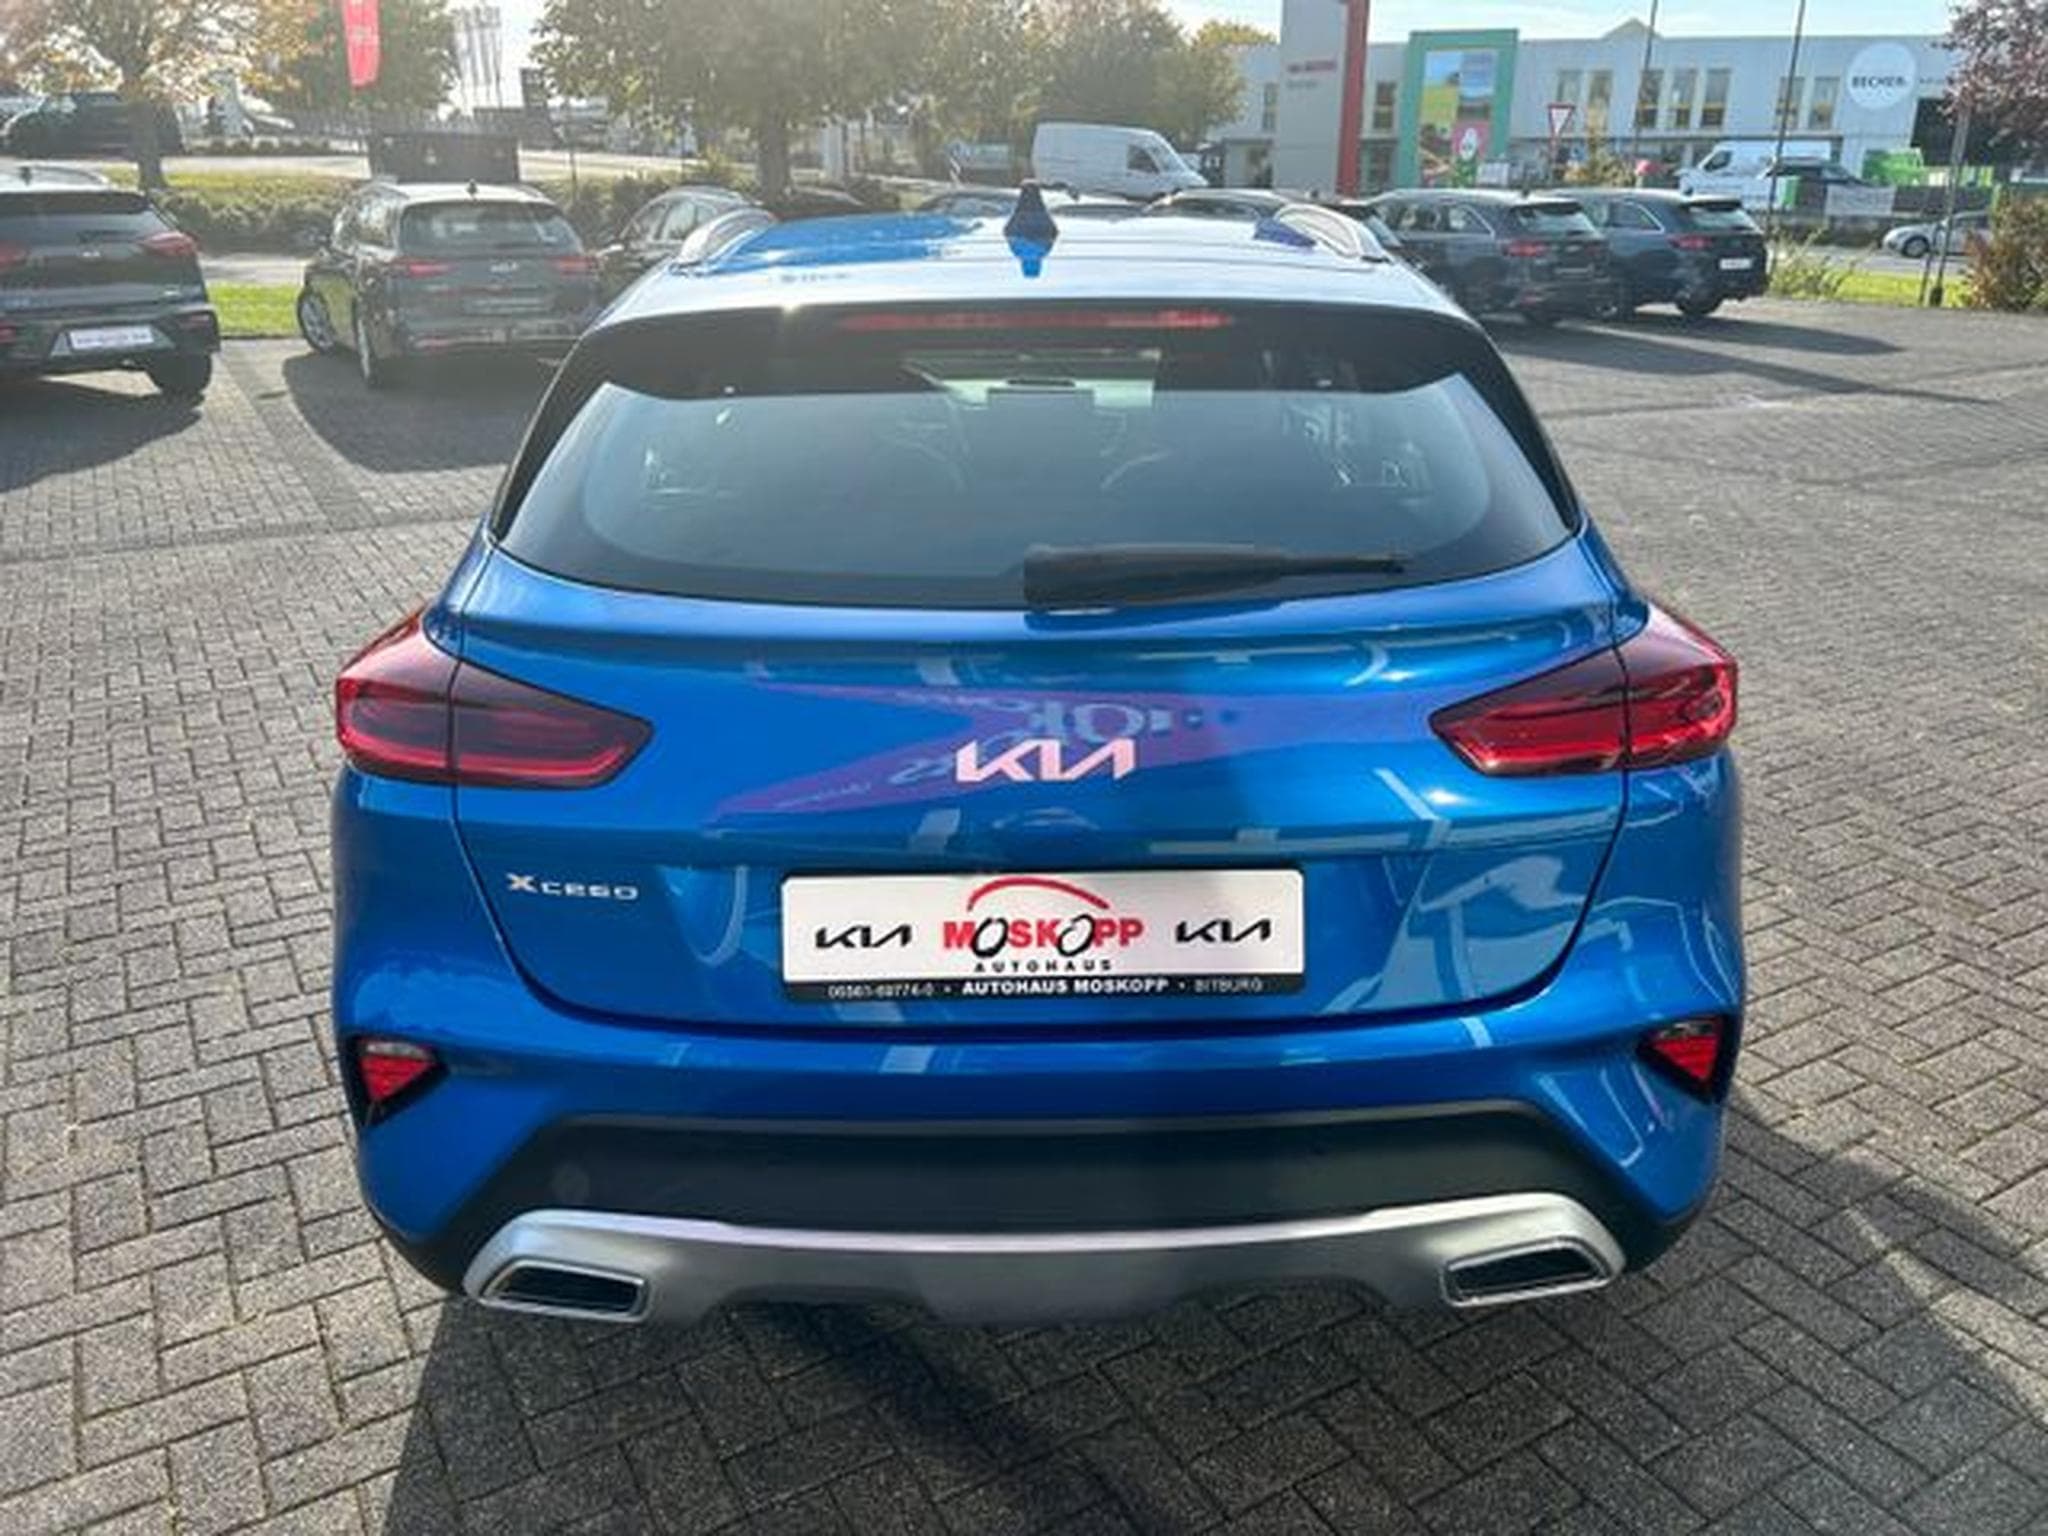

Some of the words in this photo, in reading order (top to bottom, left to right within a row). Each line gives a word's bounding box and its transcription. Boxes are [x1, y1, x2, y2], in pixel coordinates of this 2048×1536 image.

[955, 738, 1135, 782] KIA
[815, 924, 912, 948] KIA
[943, 913, 1144, 958] MOSKOPP
[1175, 918, 1271, 942] KIA
[974, 959, 1112, 973] AUTOHAUS
[962, 978, 1068, 995] AUTOHAUS
[1073, 977, 1170, 994] MOSKOPP
